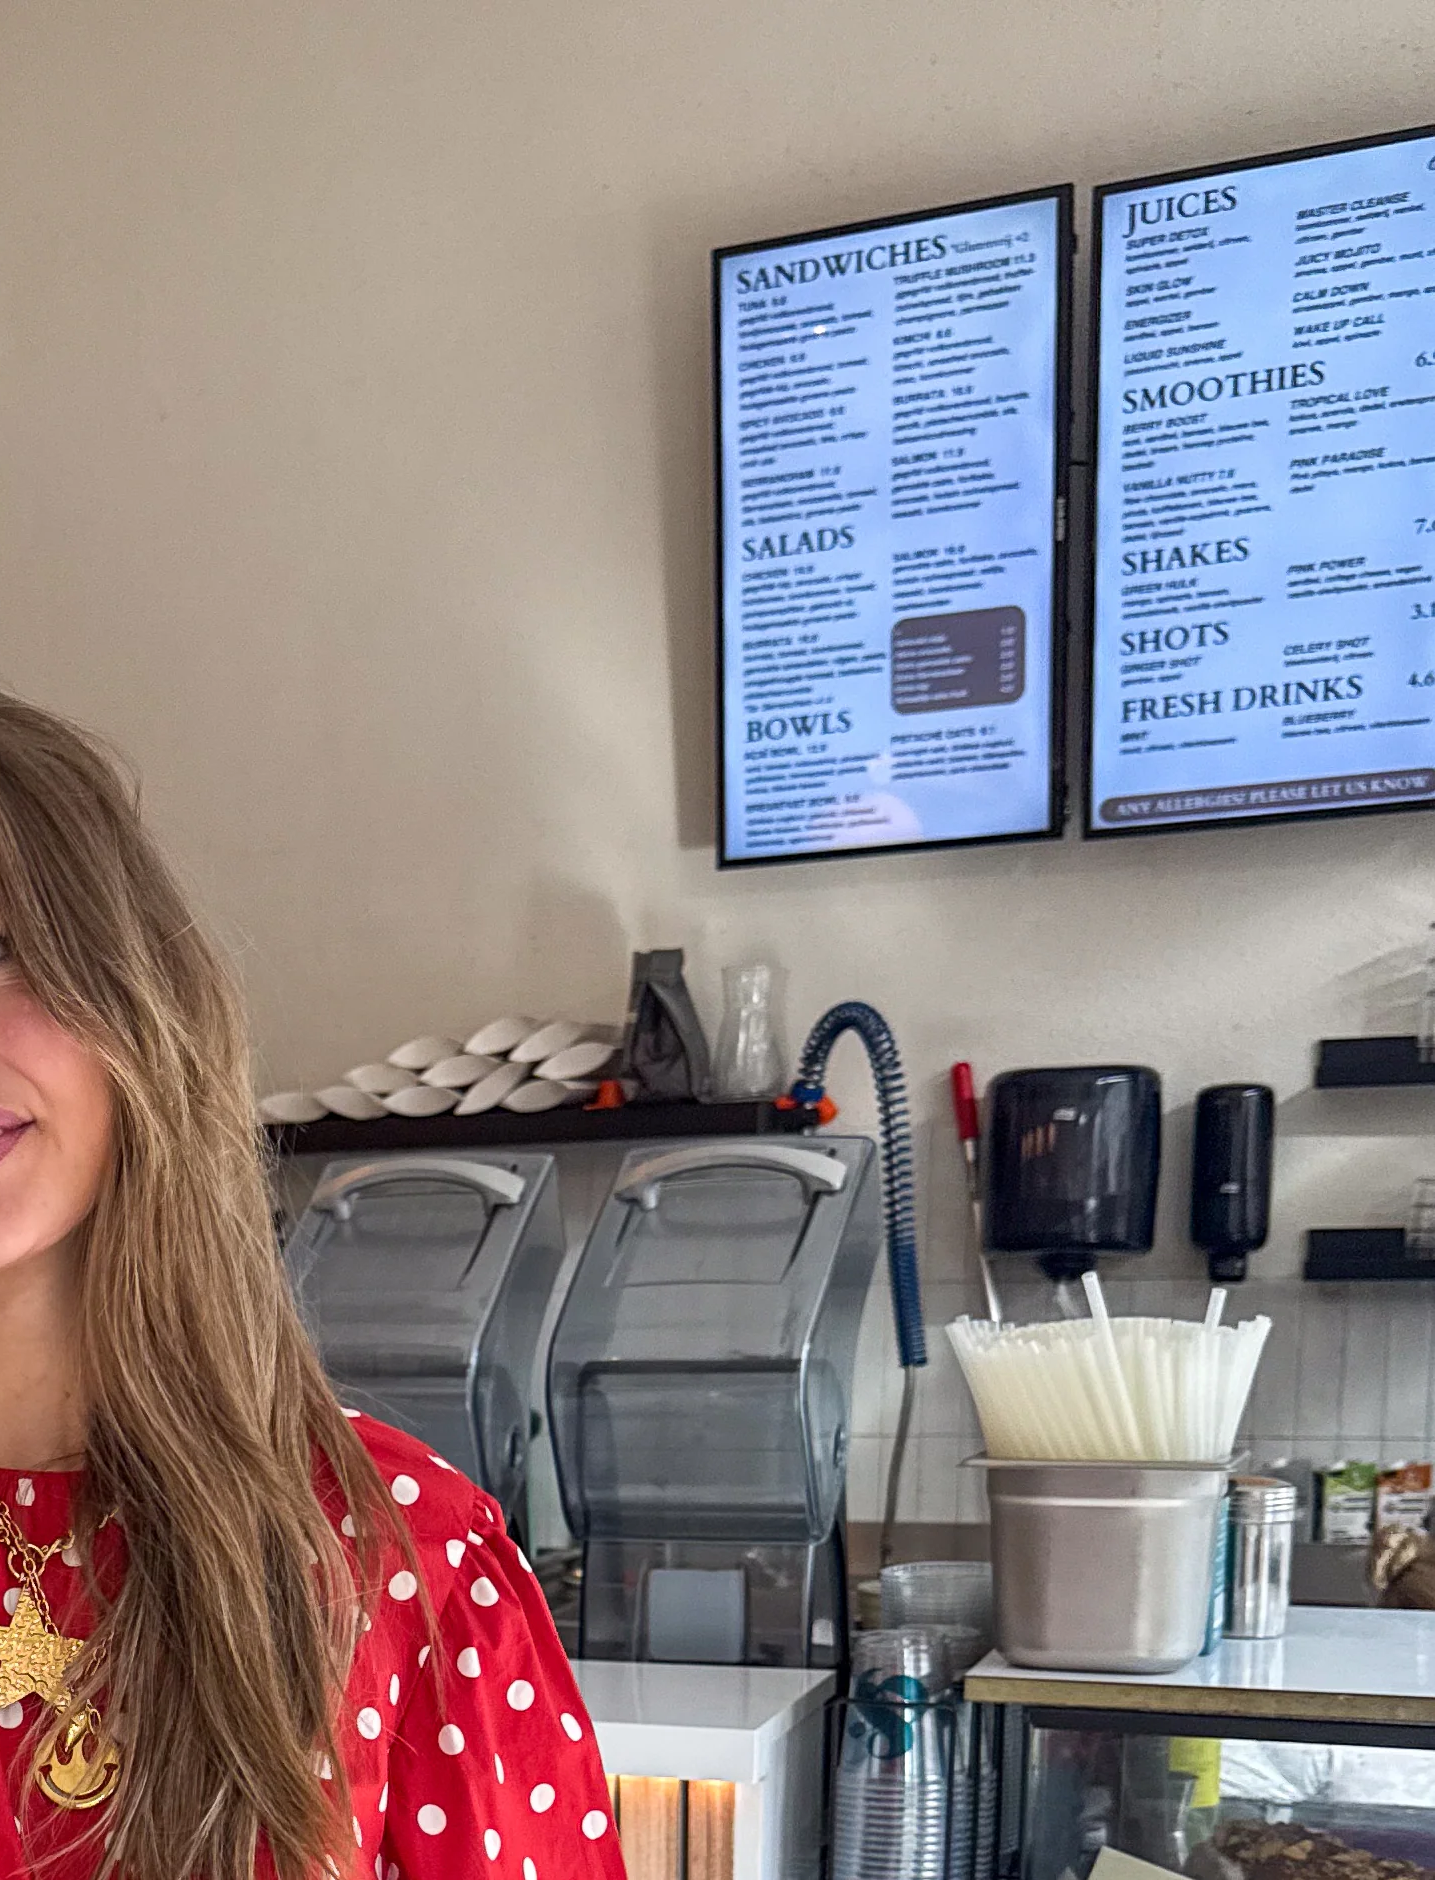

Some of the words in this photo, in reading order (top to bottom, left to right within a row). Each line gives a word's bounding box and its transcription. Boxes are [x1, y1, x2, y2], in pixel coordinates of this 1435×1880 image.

[1122, 185, 1238, 238] JUICES
[736, 234, 948, 295] SANDWICHES
[1293, 321, 1330, 336] WAKE
[1352, 314, 1386, 328] CALL
[1122, 360, 1327, 414] SMOOTHIES
[741, 525, 856, 562] SALADS
[1121, 537, 1250, 576] SHAKES
[1120, 620, 1231, 656] SHOTS
[1120, 689, 1223, 723] FRESH
[1230, 673, 1364, 712] DRINKS
[744, 709, 853, 744] BOWLS
[1117, 801, 1151, 817] ANY
[1250, 786, 1308, 804] PLEASE
[1311, 783, 1341, 799] LET
[1345, 781, 1366, 796] US
[1369, 775, 1429, 793] KNOW
